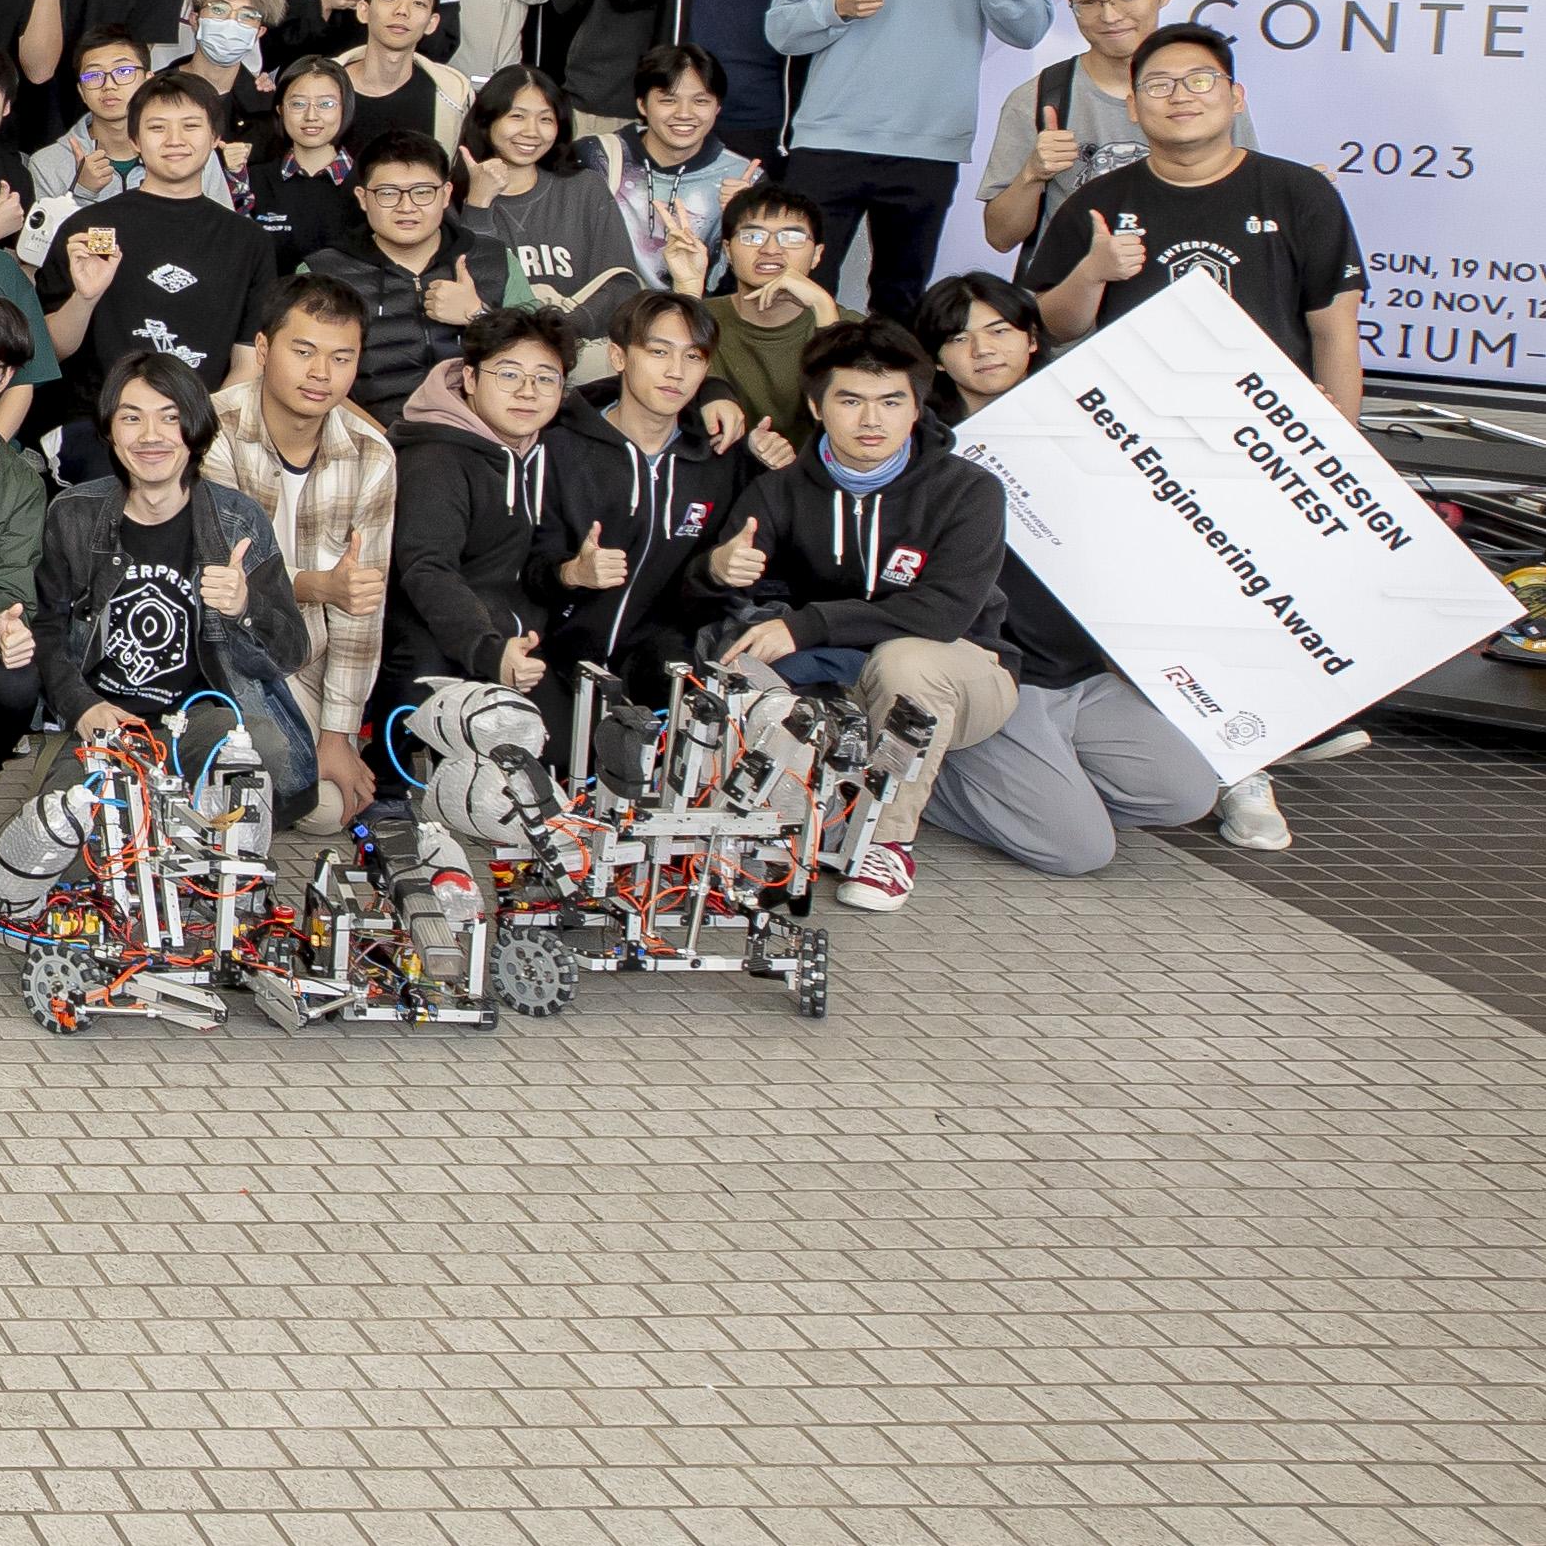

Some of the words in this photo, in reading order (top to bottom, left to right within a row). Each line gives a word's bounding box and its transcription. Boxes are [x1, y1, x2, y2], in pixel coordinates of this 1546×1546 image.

[1338, 140, 1476, 181] 2023
[1156, 241, 1240, 266] ENTERPRIZE
[1369, 253, 1437, 279] SUN,
[1449, 258, 1479, 277] 19
[1387, 290, 1423, 308] 20
[1433, 292, 1514, 320] NOV,
[1235, 371, 1325, 458] ROBOT
[1316, 455, 1414, 552] DESIGN
[1233, 426, 1350, 539] CONTEST
[1075, 387, 1142, 453] Best
[1130, 446, 1272, 598] Engineering
[1262, 594, 1357, 677] Award
[1187, 683, 1224, 713] HKUST
